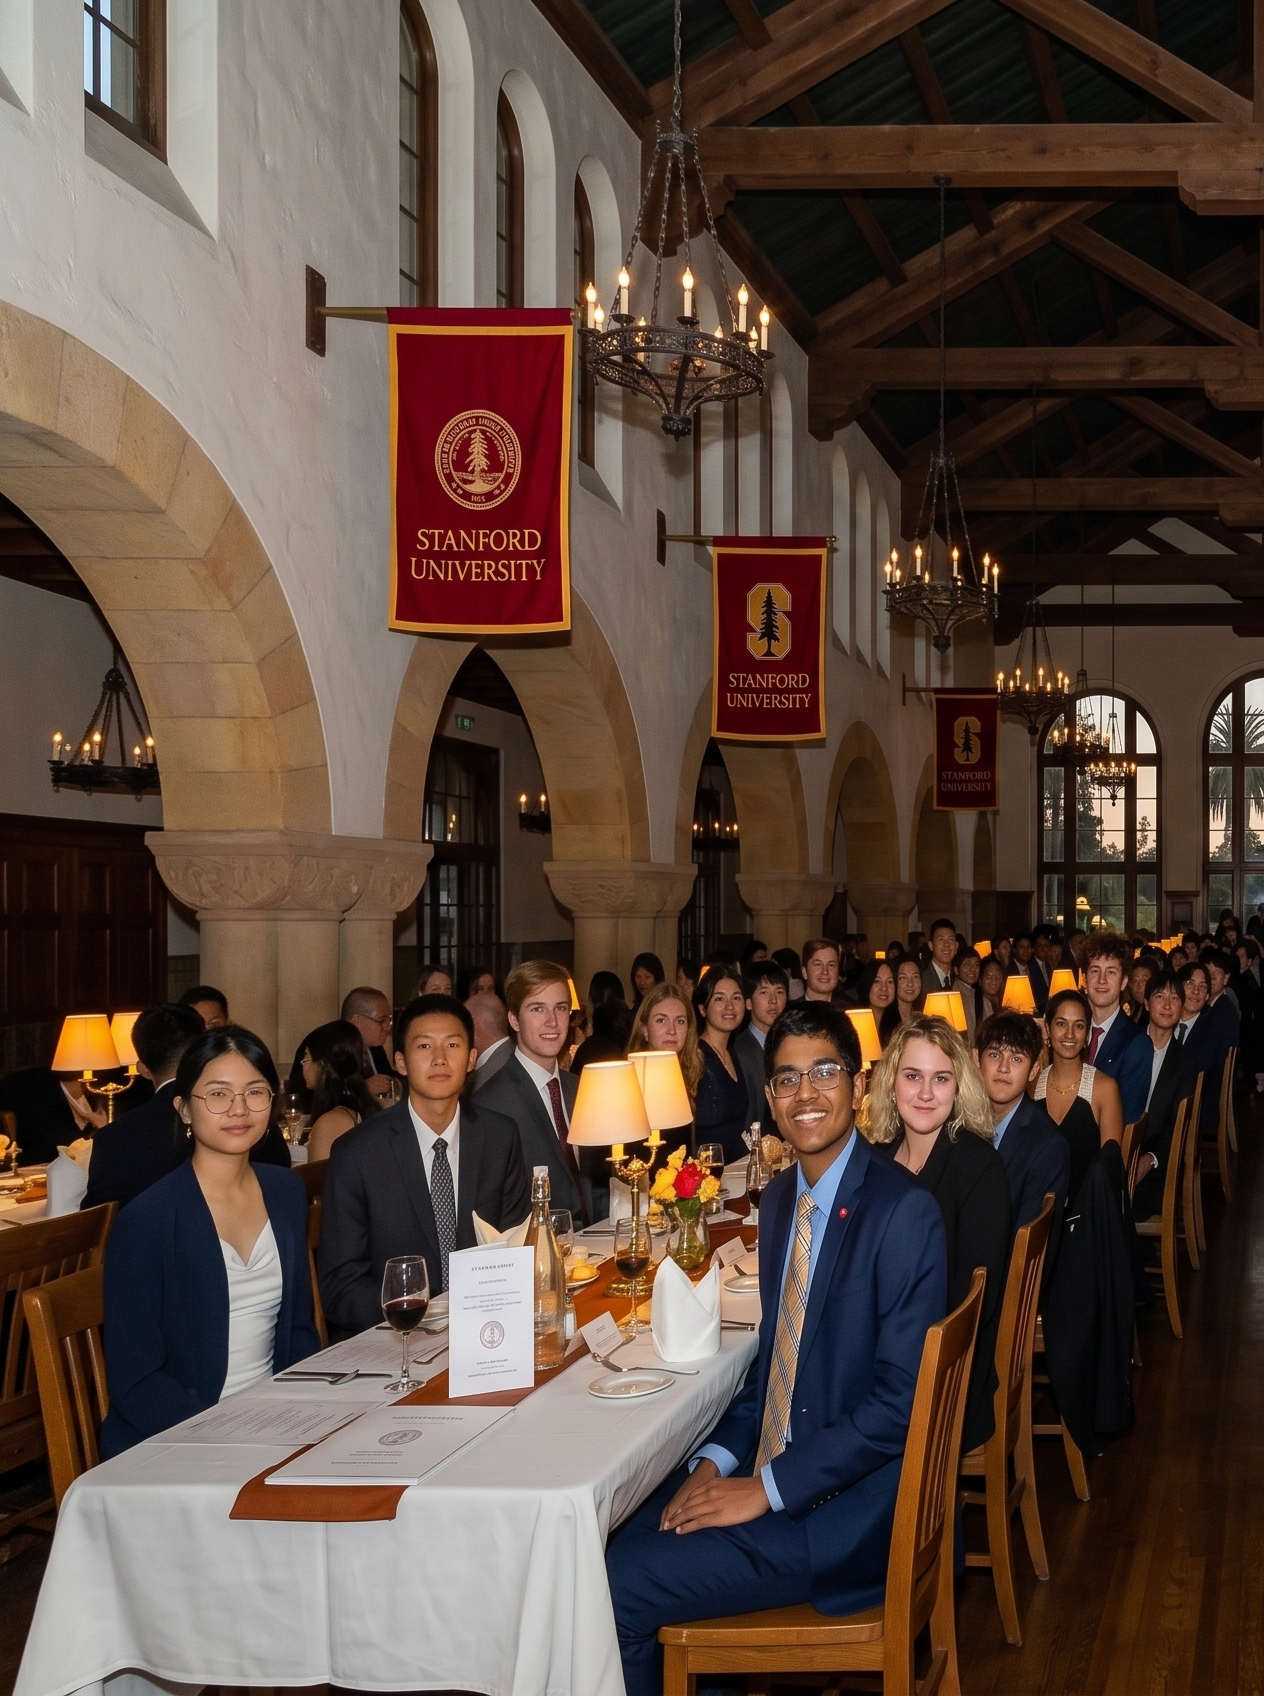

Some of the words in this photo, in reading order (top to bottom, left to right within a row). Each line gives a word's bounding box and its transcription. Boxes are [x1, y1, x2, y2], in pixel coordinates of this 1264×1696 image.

[416, 528, 542, 552] STANFORD
[410, 557, 546, 582] UNIVERSITY
[728, 672, 810, 689] STANFORD
[726, 693, 812, 709] UNIVERSITY
[941, 771, 991, 780] STANFORD
[941, 782, 992, 792] UNIVERSITY
